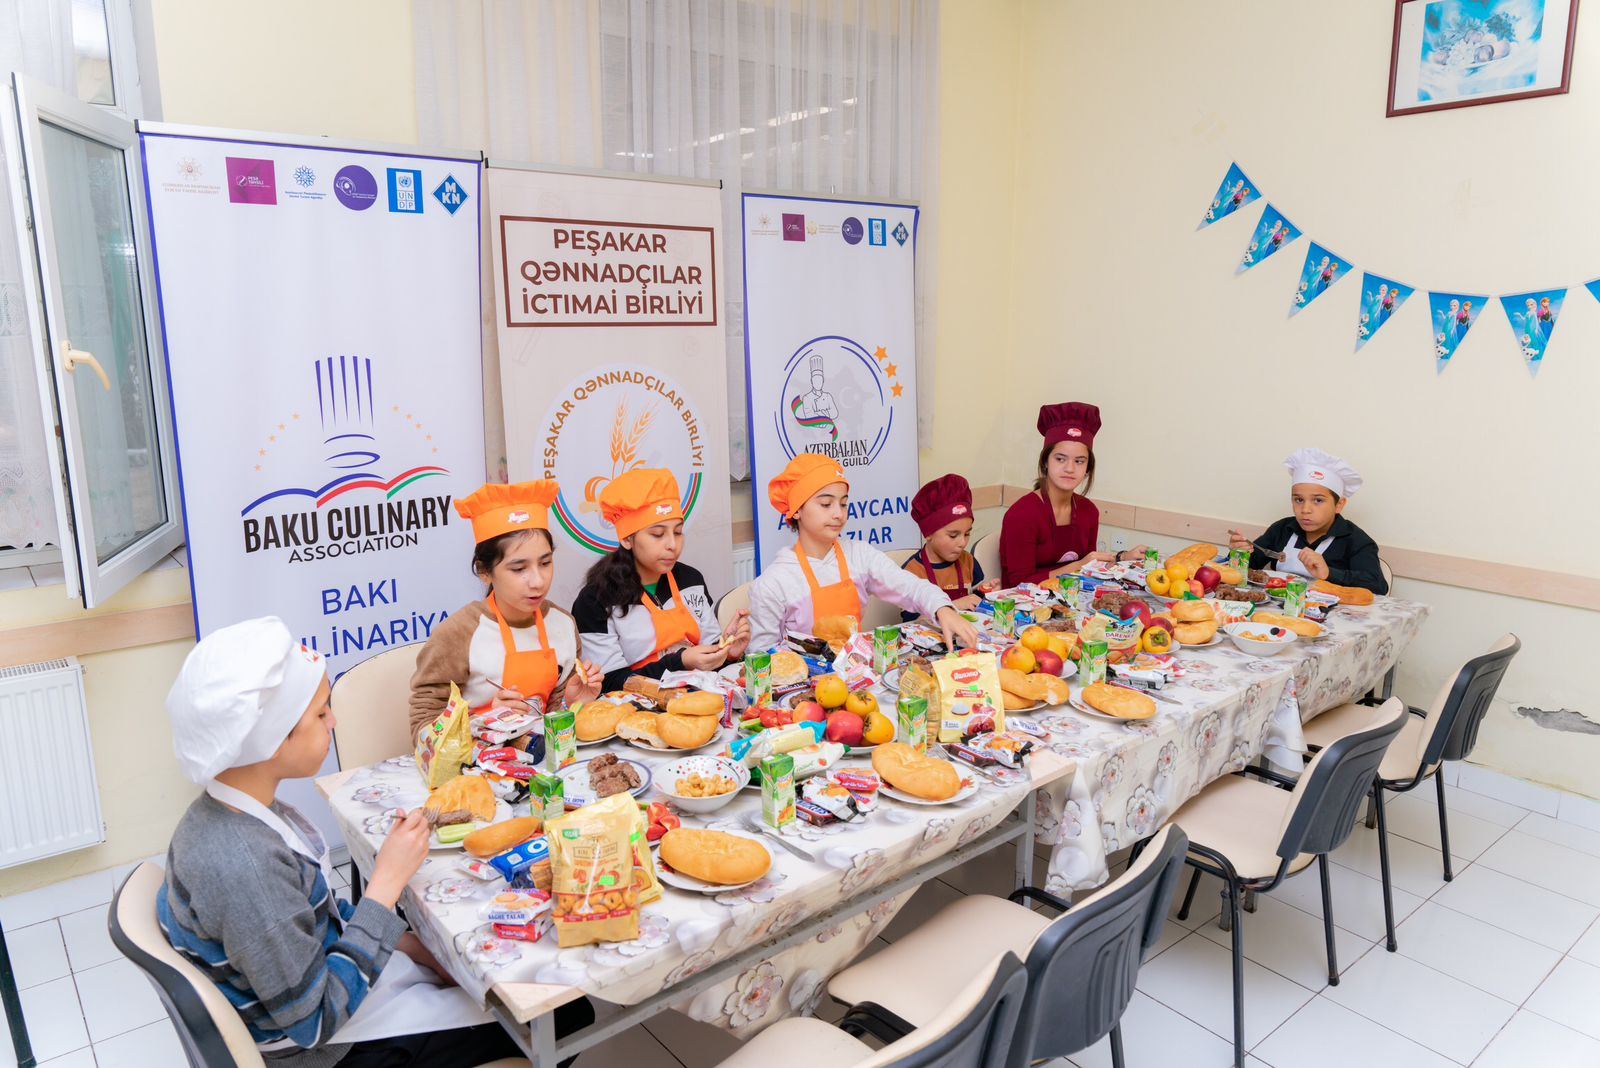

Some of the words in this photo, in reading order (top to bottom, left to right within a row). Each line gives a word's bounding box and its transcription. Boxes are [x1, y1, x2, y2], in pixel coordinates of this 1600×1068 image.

[553, 228, 668, 257] PEŞAKAR
[520, 260, 703, 289] QƏNNADÇILAR
[625, 290, 704, 315] BİRLİYİ
[543, 400, 575, 480] PEŞAKAR
[573, 370, 685, 410] QƏNNADÇILAR
[681, 409, 705, 467] BİRLİYİ
[804, 439, 868, 458] AZERBAIJAN
[842, 456, 869, 467] GUILD
[243, 511, 320, 553] BAKU
[327, 495, 452, 541] CULINARY
[288, 532, 418, 564] ASSOCIATION
[321, 578, 398, 616] BAKI
